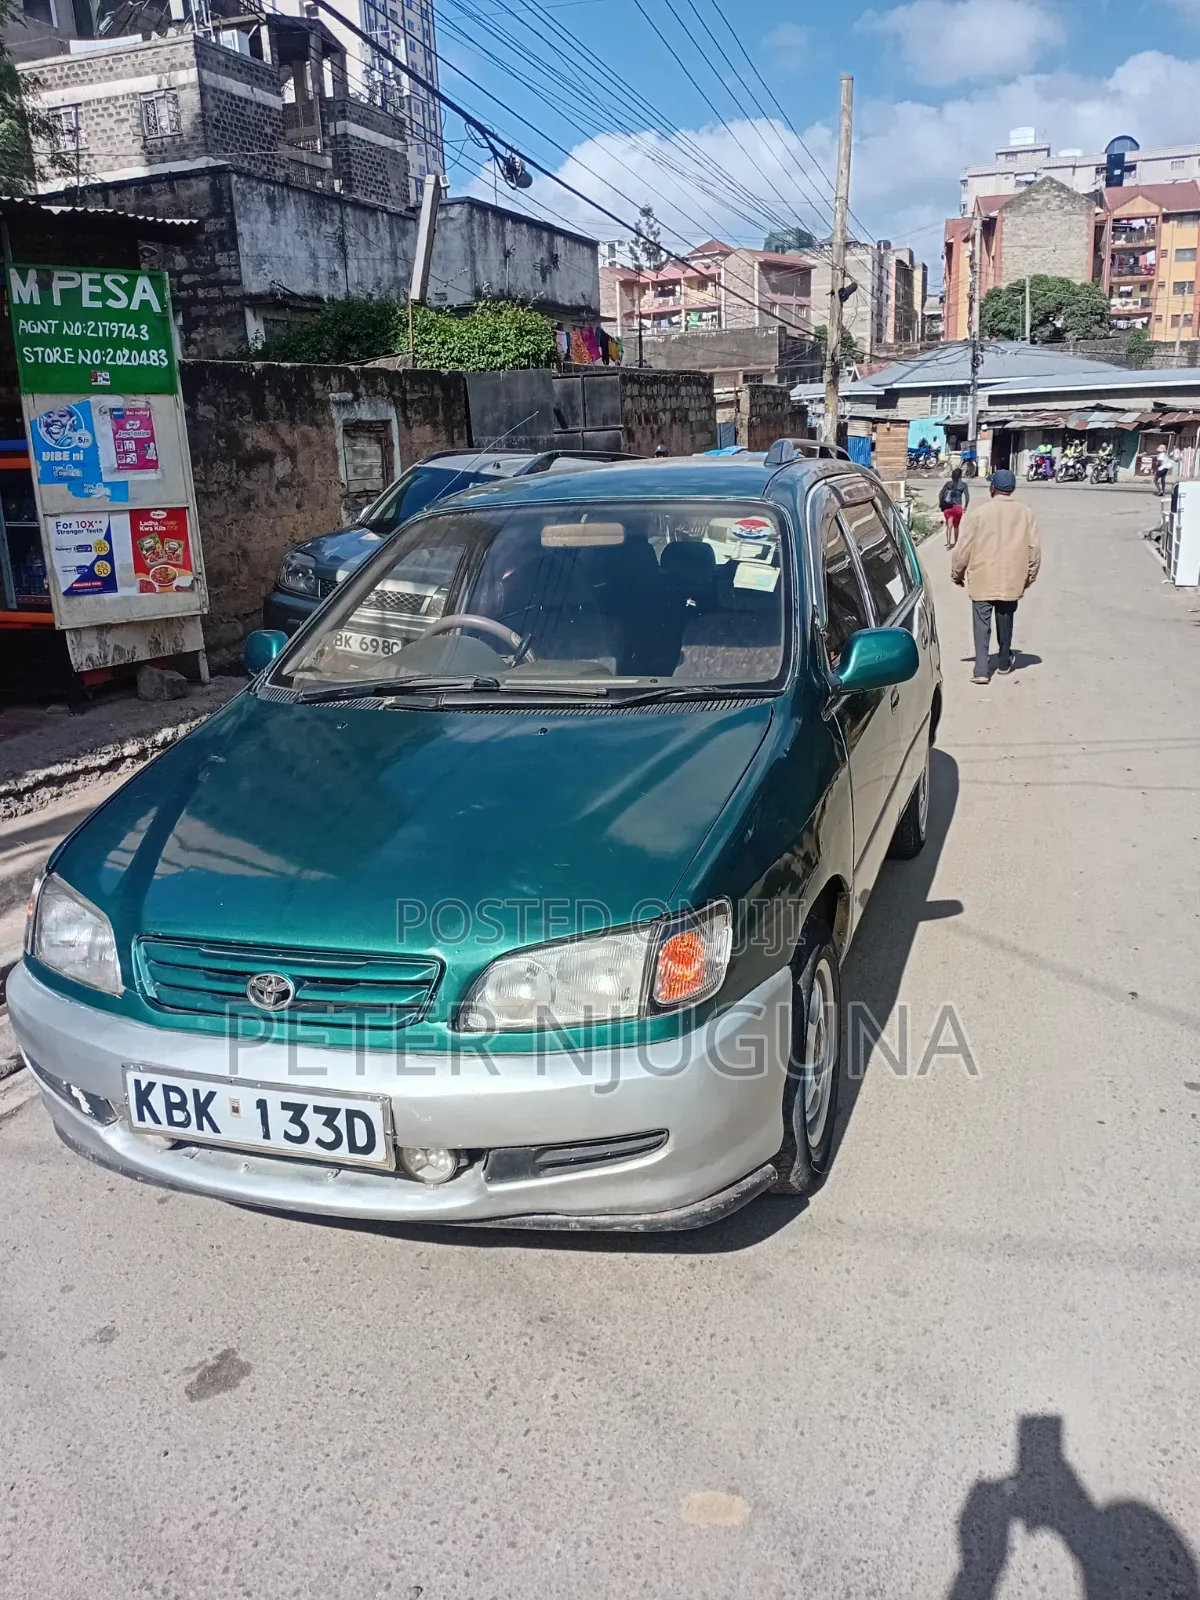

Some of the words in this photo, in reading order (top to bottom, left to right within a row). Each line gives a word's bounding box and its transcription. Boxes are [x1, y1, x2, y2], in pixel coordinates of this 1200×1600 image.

[9, 267, 41, 305] M
[52, 270, 162, 313] PESA
[18, 320, 59, 335] AGNT
[63, 321, 149, 340] NO:2179743
[23, 347, 76, 363] STORE
[78, 348, 168, 367] NO:2020483
[72, 450, 84, 461] ni
[55, 521, 73, 529] For
[333, 633, 352, 648] BK
[133, 1078, 222, 1135] KBK
[256, 1098, 376, 1156] 133D
